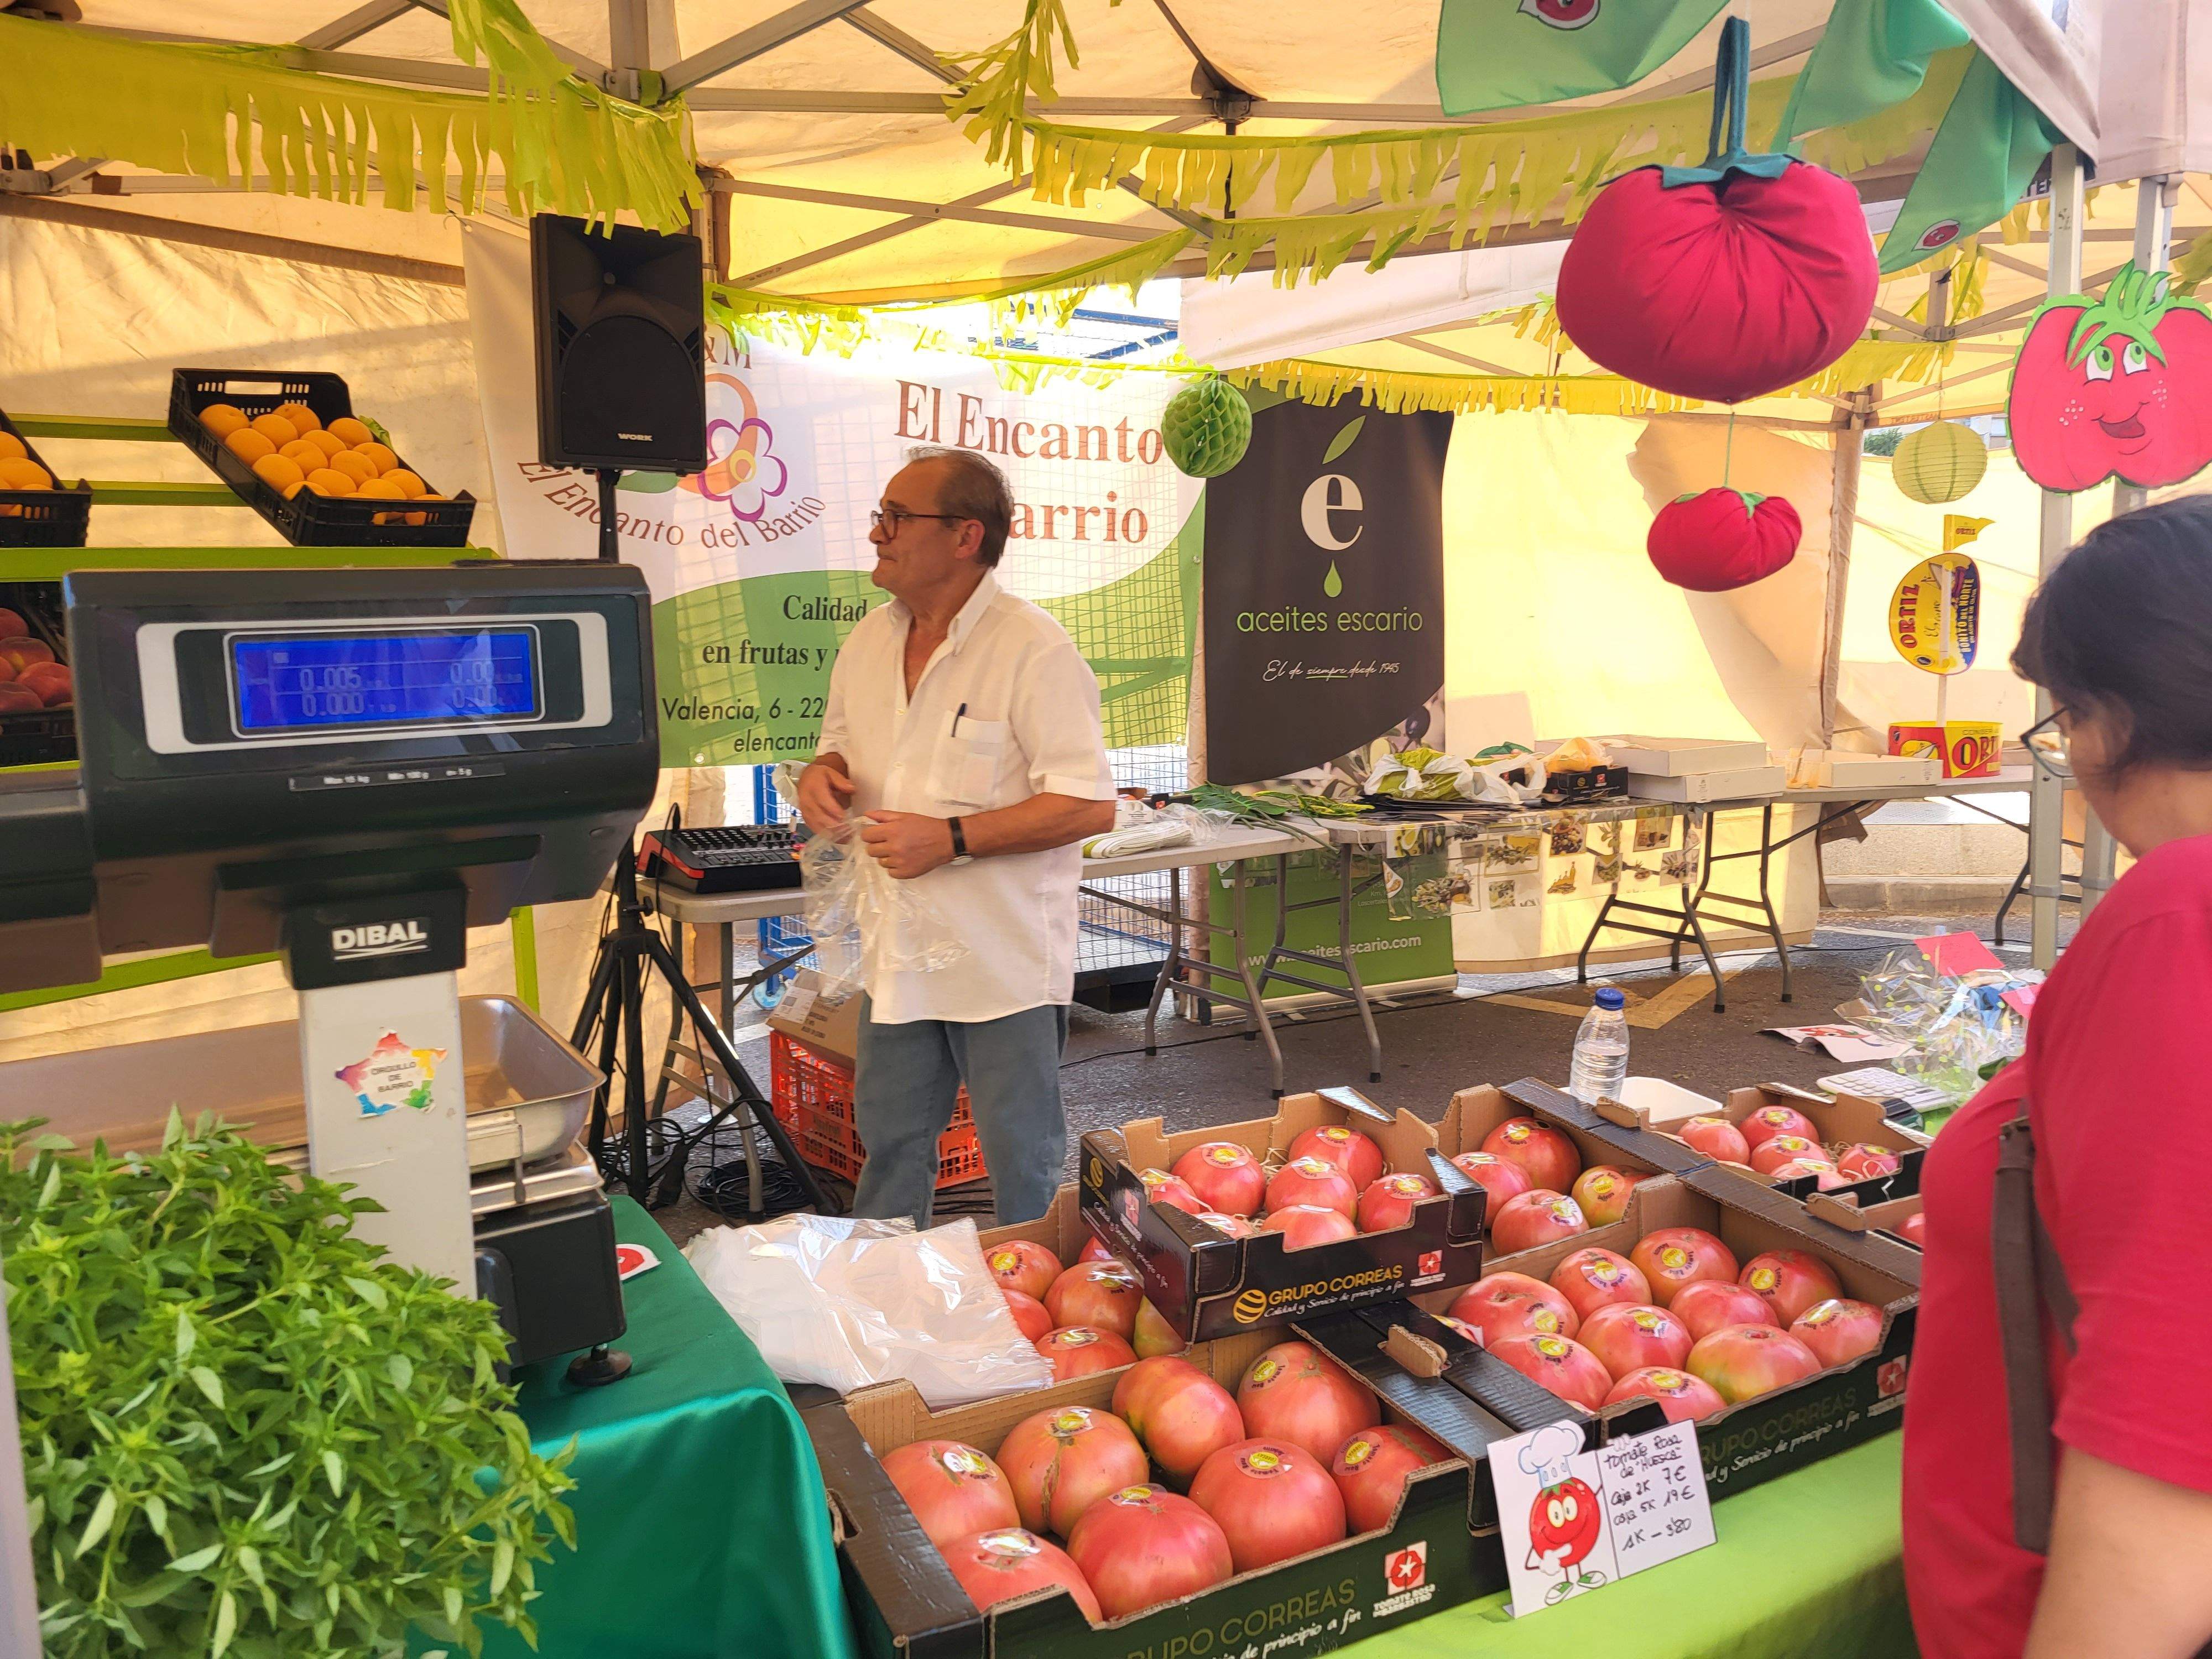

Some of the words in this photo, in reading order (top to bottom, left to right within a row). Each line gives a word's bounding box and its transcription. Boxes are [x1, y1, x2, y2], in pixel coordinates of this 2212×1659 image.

[618, 432, 653, 441] WORK
[894, 379, 941, 443] El
[956, 393, 1164, 465] Encanto
[518, 461, 571, 482] El
[700, 523, 750, 548] del
[754, 496, 827, 543] Barrio
[1009, 491, 1148, 543] arrio
[783, 595, 868, 622] Calidad
[1237, 606, 1328, 632] aceites
[1337, 606, 1423, 632] escario
[1898, 584, 1920, 649] ORTIZ
[703, 645, 731, 664] en
[739, 640, 810, 665] frutas
[814, 648, 830, 671] y
[300, 667, 362, 692] 0.005
[1262, 660, 1289, 681] El
[1288, 661, 1304, 680] de
[1306, 666, 1348, 681] siempre
[1348, 660, 1378, 678] desde
[301, 691, 365, 718] 0.000
[662, 696, 761, 724] Valencia,
[769, 697, 781, 718] 6
[800, 697, 828, 718] 22
[332, 921, 427, 950] DIBAL
[371, 1061, 417, 1074] ORGULLO
[378, 1081, 413, 1092] BARRIO
[1268, 1281, 1328, 1305] GRUPO
[1329, 1264, 1404, 1292] CORREAS
[1700, 1427, 1759, 1464] RUPO
[1762, 1387, 1856, 1441] CORREAS
[1219, 1578, 1357, 1645] CORREAS
[1262, 1621, 1323, 1659] principio
[1327, 1618, 1338, 1631] a
[1338, 1607, 1362, 1635] fin
